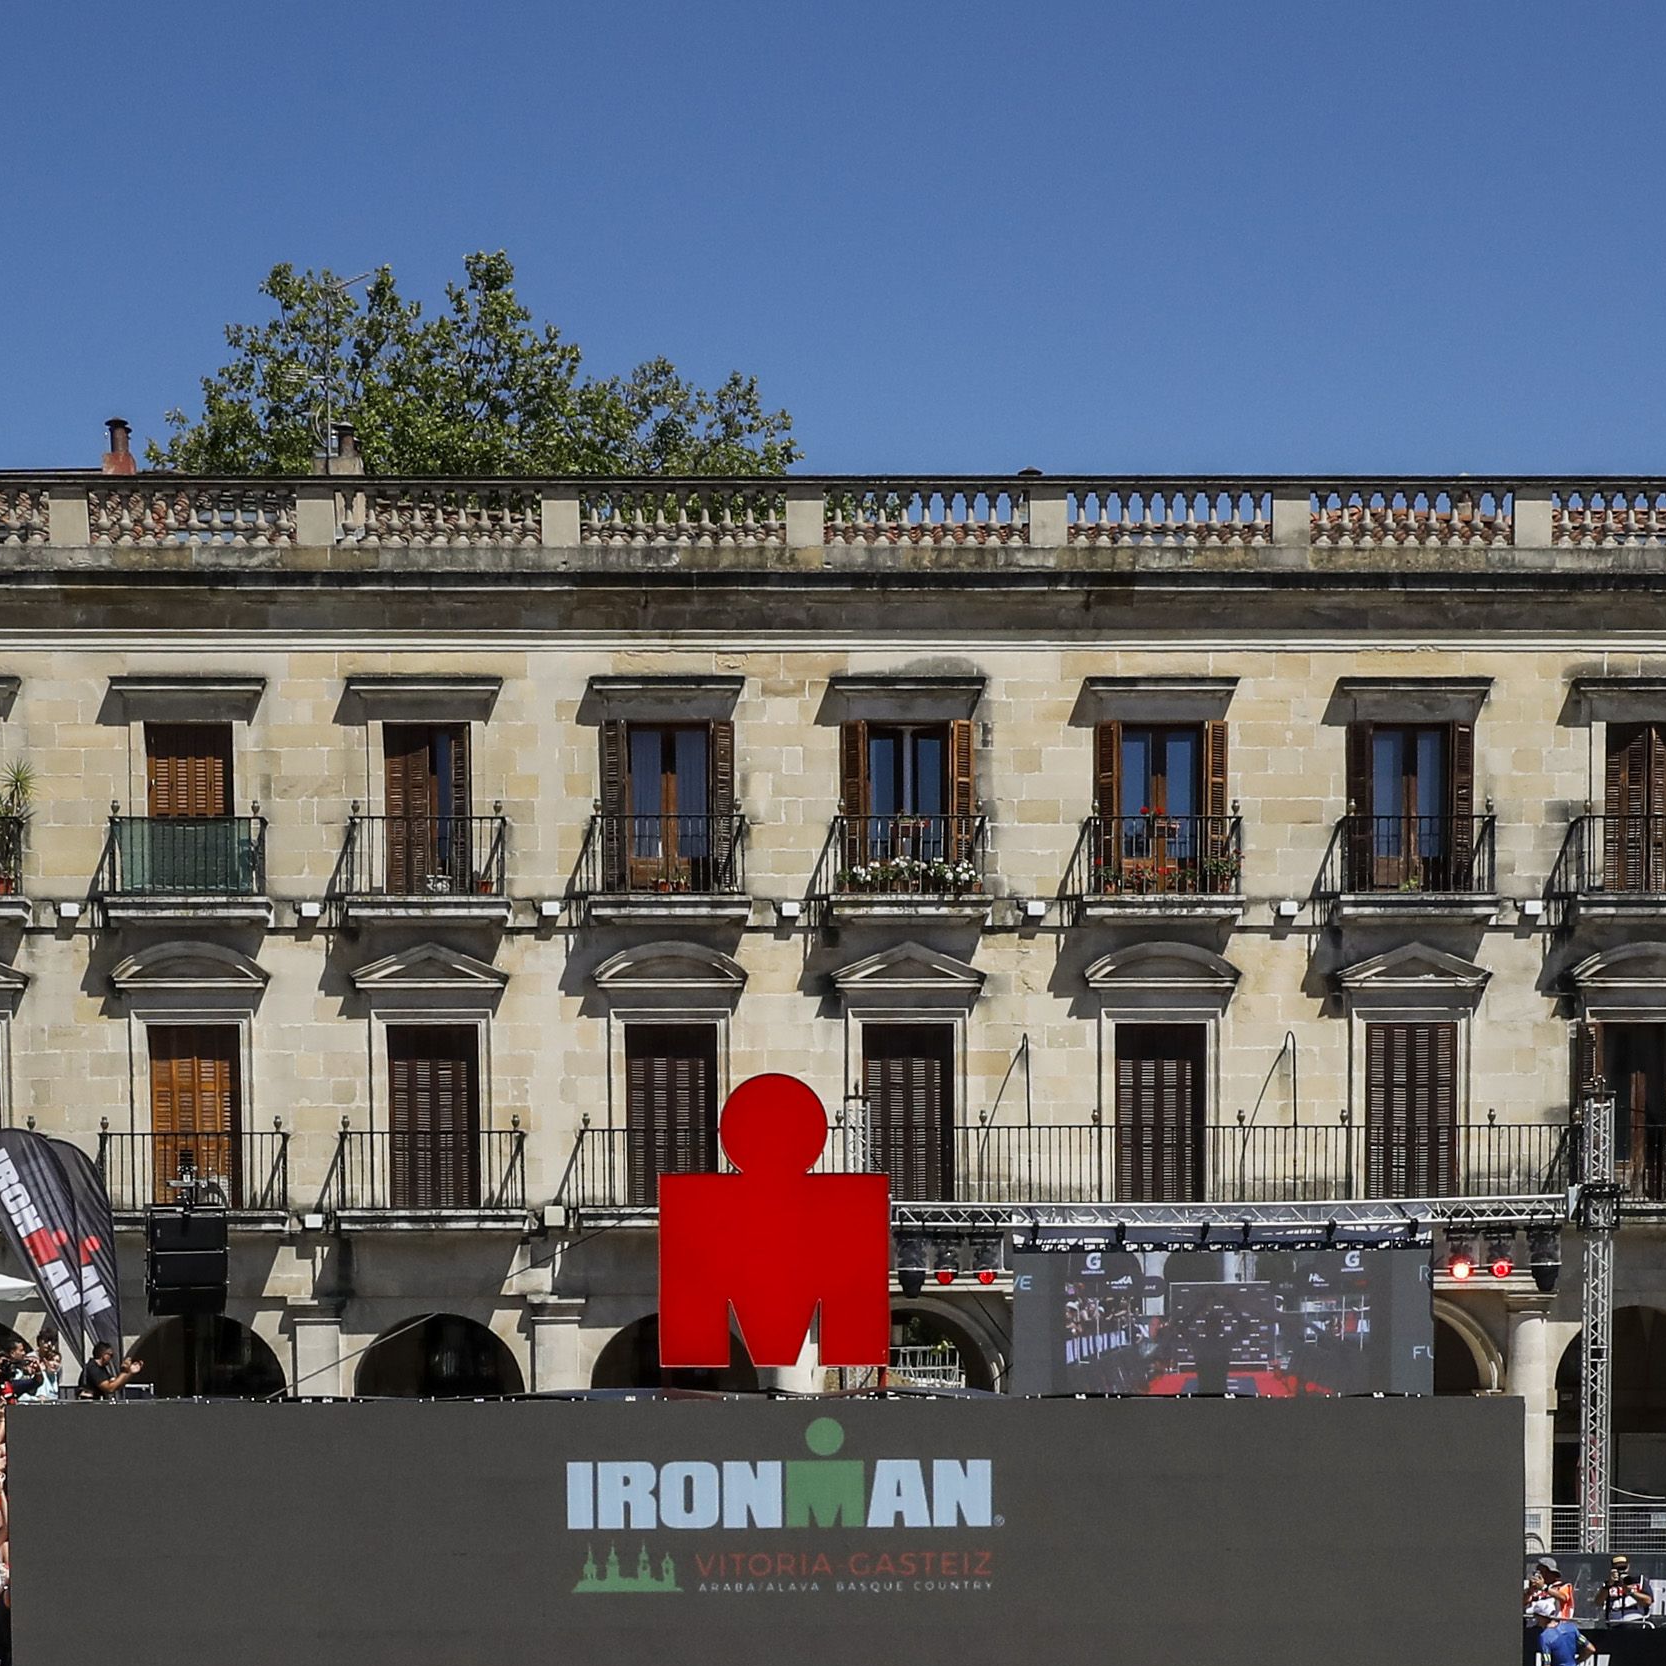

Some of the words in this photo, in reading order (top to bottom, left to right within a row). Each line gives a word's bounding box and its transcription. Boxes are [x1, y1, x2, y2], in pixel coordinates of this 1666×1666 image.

[567, 1417, 992, 1529] IRONMAN
[836, 1580, 904, 1593] BASQUE
[913, 1579, 993, 1592] COUNTRY
